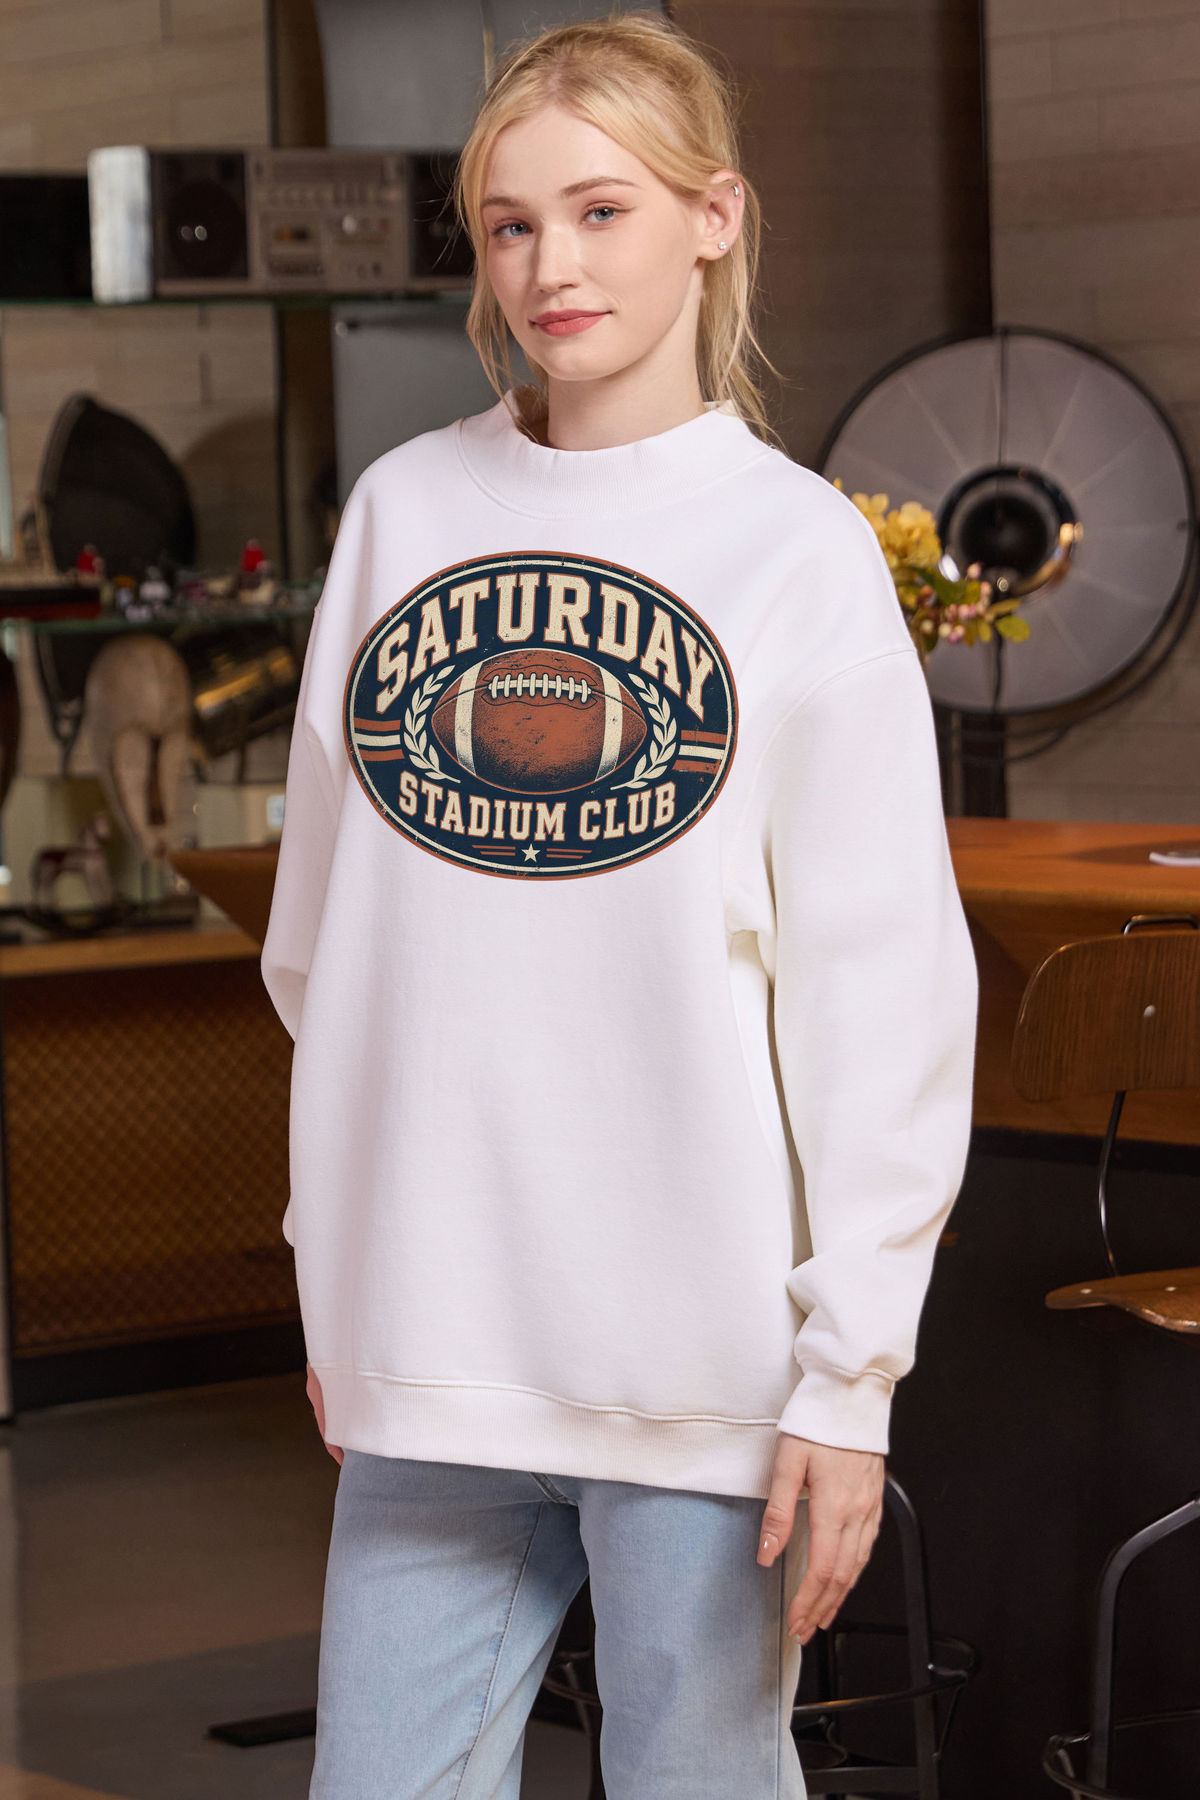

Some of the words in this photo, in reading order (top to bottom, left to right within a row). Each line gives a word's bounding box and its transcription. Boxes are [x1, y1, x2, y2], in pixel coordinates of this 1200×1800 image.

[376, 572, 714, 723] SATURDAY
[399, 770, 567, 841] STADIUM
[579, 781, 676, 841] CLUB
